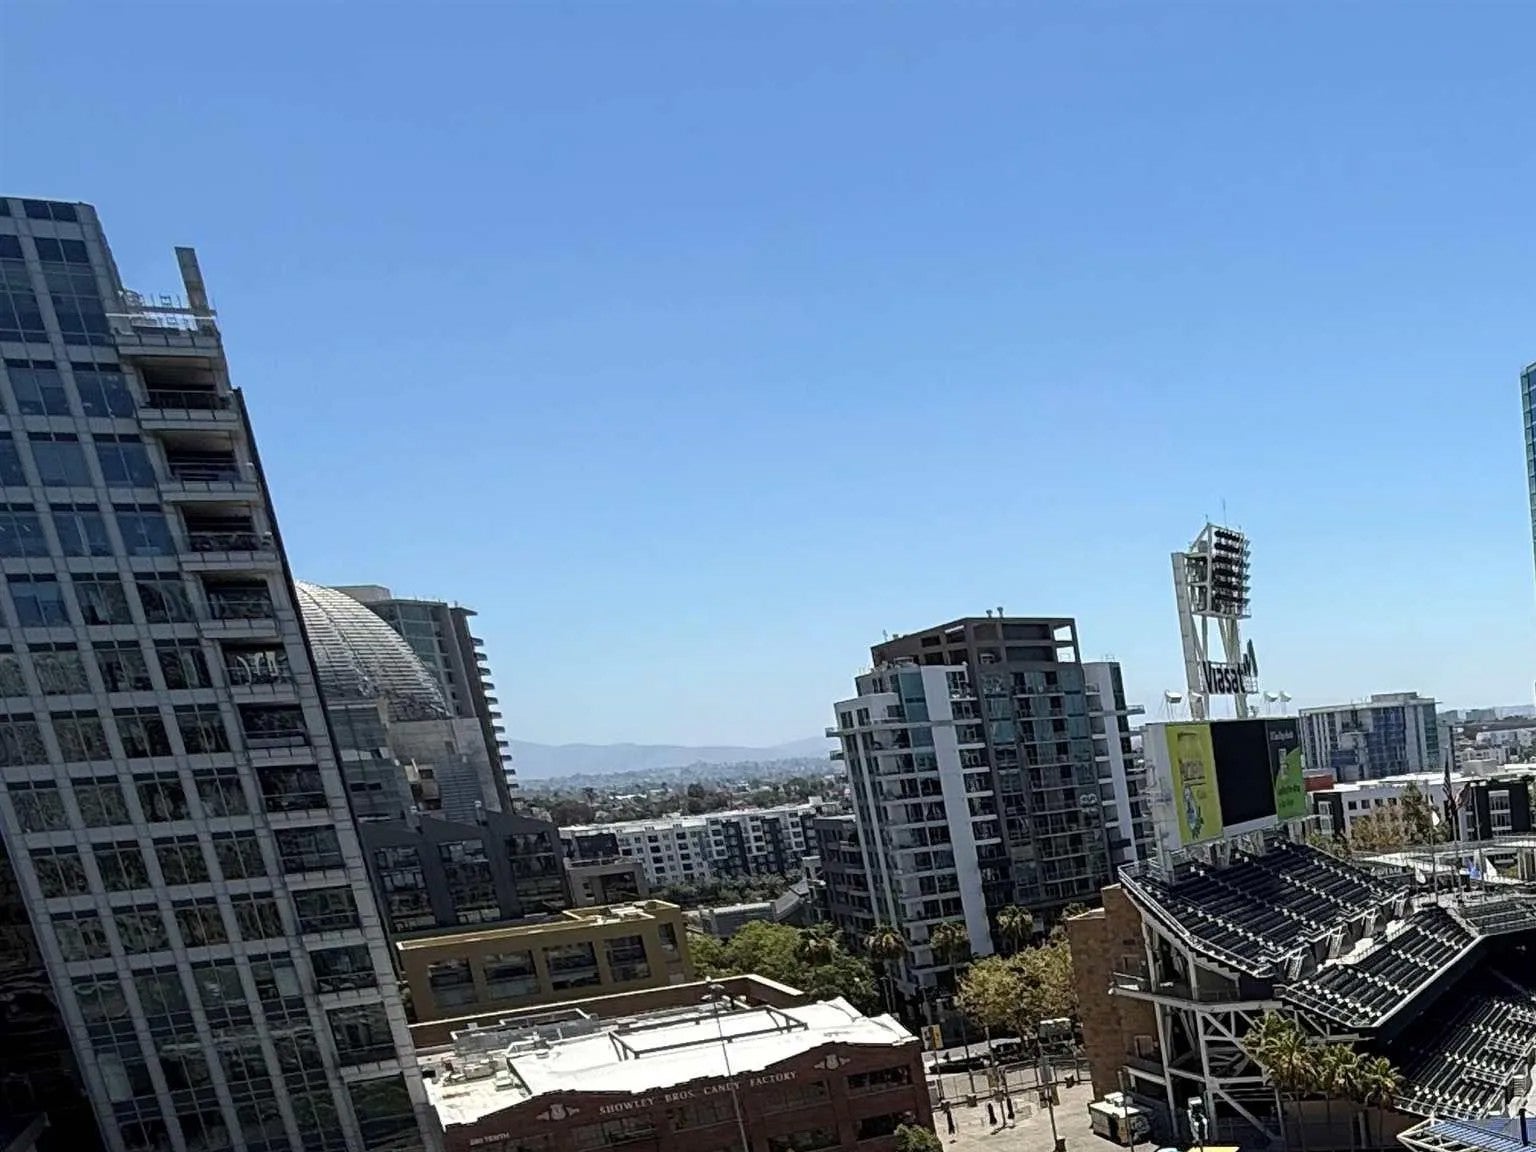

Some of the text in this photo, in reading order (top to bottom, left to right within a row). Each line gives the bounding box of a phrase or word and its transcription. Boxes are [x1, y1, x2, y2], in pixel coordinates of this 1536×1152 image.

[1202, 660, 1246, 694] Viasat
[599, 1097, 655, 1114] SHOWLEY
[750, 1070, 798, 1087] FACTORY
